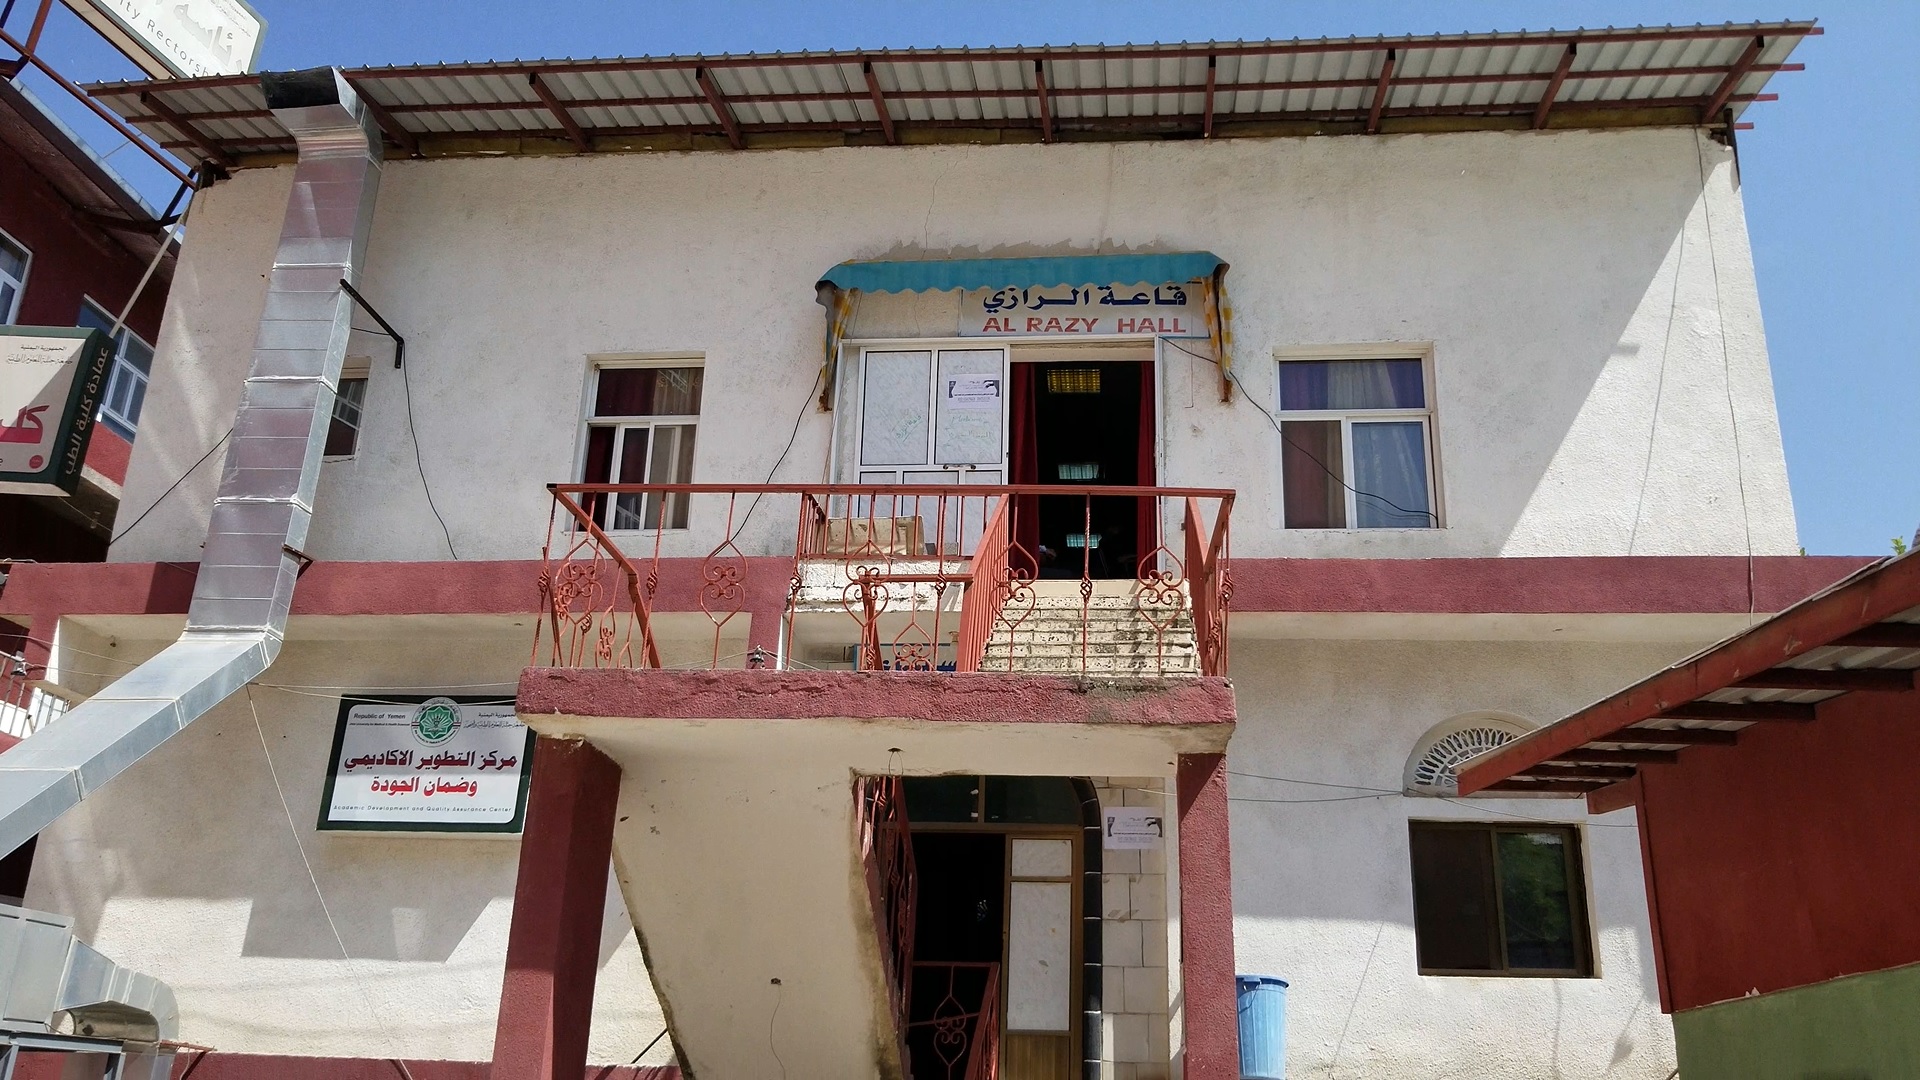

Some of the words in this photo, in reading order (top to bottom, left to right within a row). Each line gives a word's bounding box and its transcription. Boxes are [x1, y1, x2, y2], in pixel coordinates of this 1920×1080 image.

[147, 19, 209, 77] Rectorsh
[983, 287, 1089, 314] الرازي
[1097, 285, 1187, 306] قاعة
[982, 317, 1017, 333] AL
[1026, 317, 1099, 333] RAZY
[1117, 317, 1187, 333] HALL
[87, 347, 109, 394] عمادة
[75, 394, 93, 431] كلية
[65, 433, 83, 476] الطب
[344, 750, 414, 773] الاكاديمي
[415, 750, 476, 771] التطوير
[477, 750, 518, 771] مركز
[371, 776, 420, 796] الجودة
[423, 776, 478, 797] وضمان
[367, 804, 410, 812] Development
